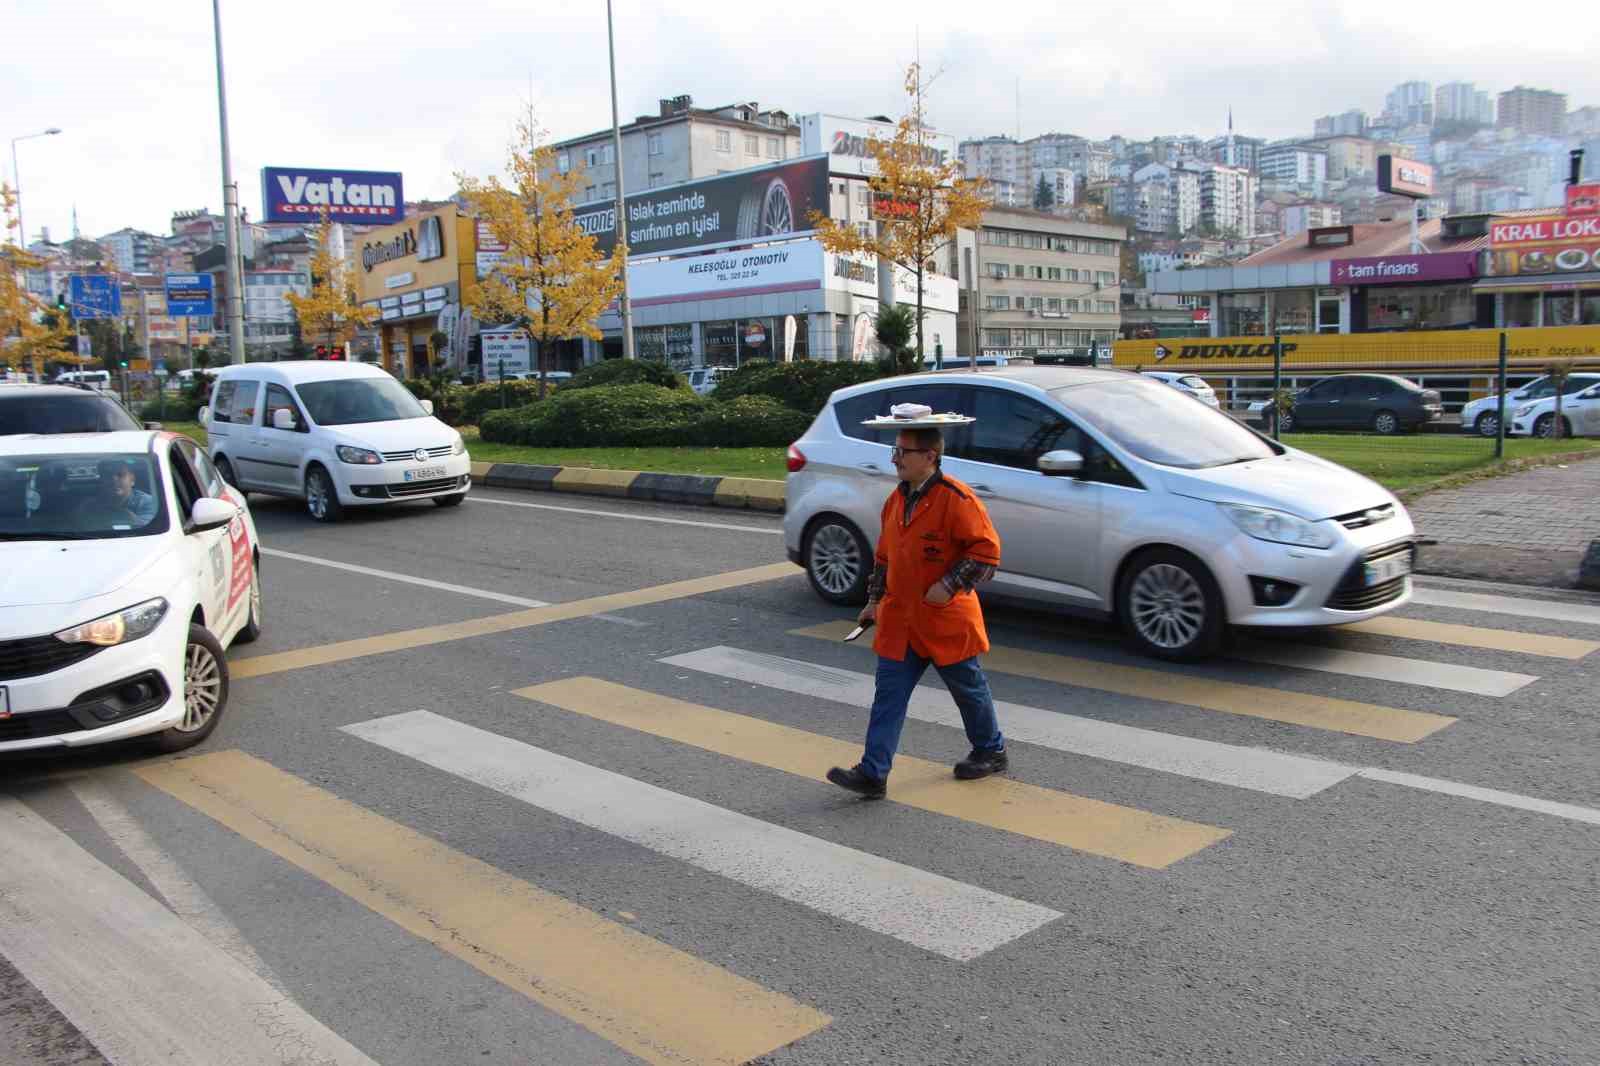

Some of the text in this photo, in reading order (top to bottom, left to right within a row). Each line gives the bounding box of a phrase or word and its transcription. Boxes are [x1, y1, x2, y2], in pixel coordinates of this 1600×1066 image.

[276, 175, 396, 207] Vatan
[282, 204, 391, 215] COMPUTER
[629, 191, 705, 222] Islak zeminde
[630, 211, 720, 244] sınıfının en iyisi!
[1493, 218, 1600, 242] KRAL LOK
[742, 252, 790, 268] OTOMOTİV
[1348, 261, 1419, 277] tam finans
[1178, 343, 1298, 359] DUNLOP
